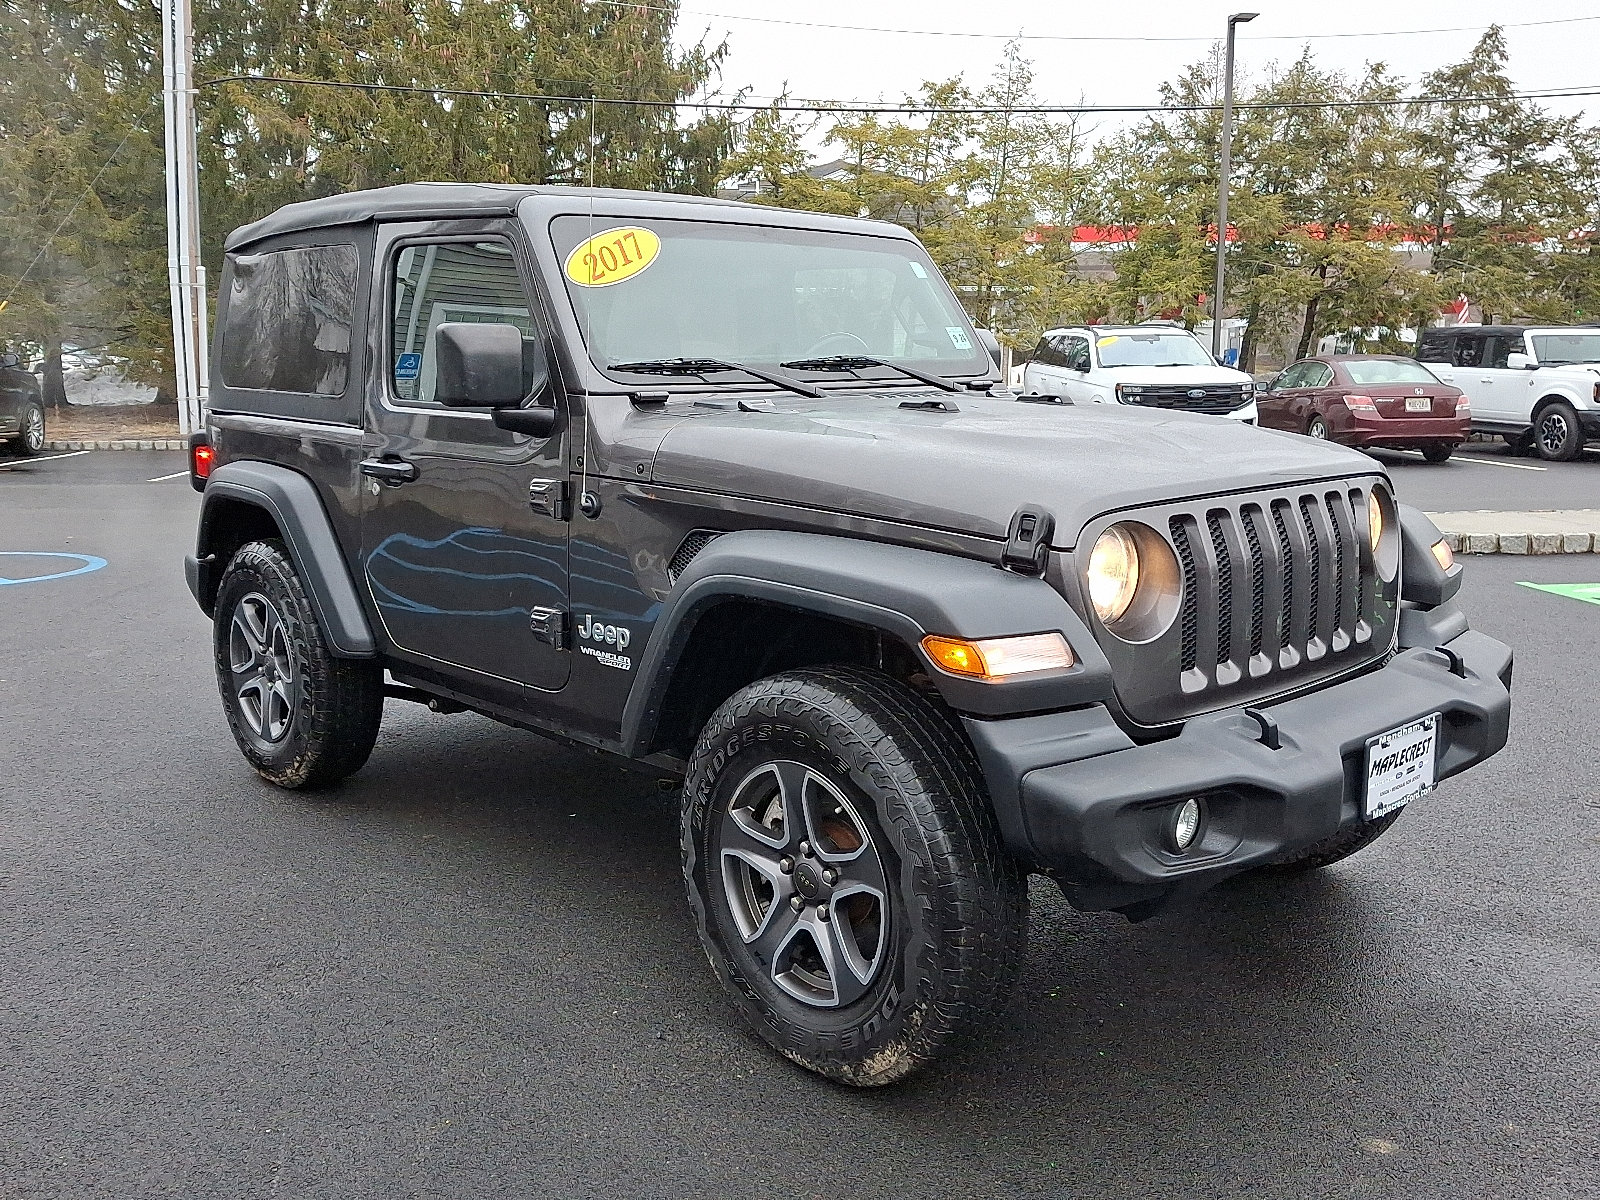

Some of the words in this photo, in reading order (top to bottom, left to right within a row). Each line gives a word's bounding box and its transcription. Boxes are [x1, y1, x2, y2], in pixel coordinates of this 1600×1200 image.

[583, 232, 643, 281] 2017
[577, 613, 631, 652] Jeep
[579, 645, 631, 665] WRANGLER
[1424, 716, 1436, 728] NJ
[691, 722, 852, 832] BRIDGESTONE
[1369, 736, 1433, 779] MAPLECREST
